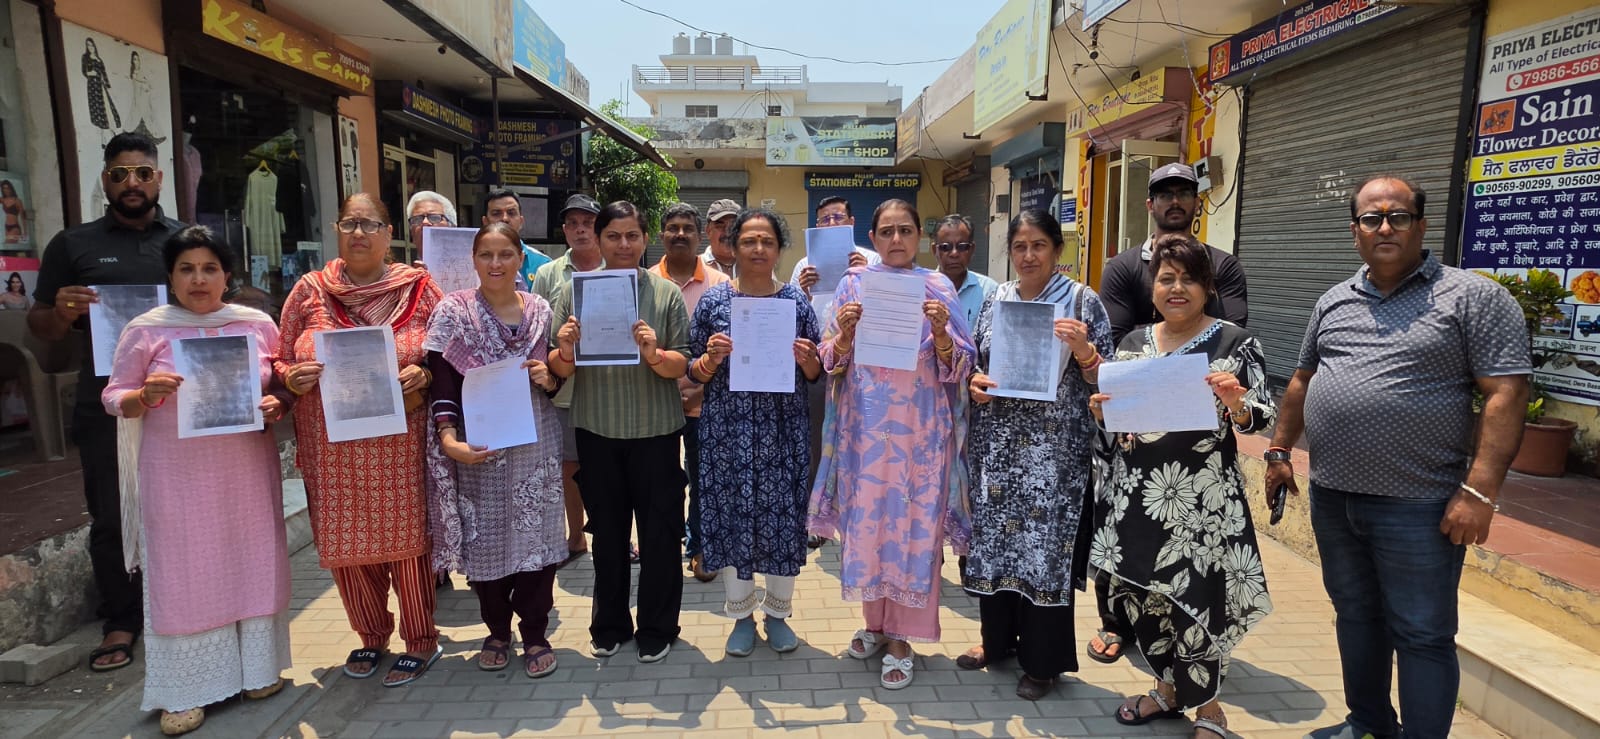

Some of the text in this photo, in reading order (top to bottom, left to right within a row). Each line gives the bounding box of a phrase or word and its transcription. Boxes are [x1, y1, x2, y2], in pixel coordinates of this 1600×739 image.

[1230, 61, 1240, 72] ALL
[1239, 56, 1256, 70] TYPES
[1264, 41, 1297, 61] ELECTRICAL
[1299, 32, 1318, 48] ITEMS
[1318, 17, 1354, 39] REPAIRING
[1241, 30, 1277, 59] PRIYA
[1492, 35, 1535, 60] PRIYA
[1489, 62, 1504, 75] All
[1507, 57, 1533, 71] Type
[1536, 50, 1549, 63] of
[312, 52, 371, 91] Camp
[412, 91, 473, 134] DASHMESH PHOTO FRAMING
[1520, 88, 1593, 127] Sain
[498, 121, 536, 132] DASHMESH
[817, 129, 896, 139] STATIONERY
[488, 132, 512, 143] POTO
[1477, 126, 1600, 154] Flower Decor
[823, 147, 889, 157] GIFT SHOP
[1482, 158, 1504, 176] ਸੈਨ
[809, 178, 864, 187] STATIONERY
[873, 179, 891, 187] GIFT
[894, 179, 918, 187] SHOP
[1485, 174, 1600, 194] 90569-90299, 905609
[1516, 196, 1527, 206] पर
[1530, 195, 1549, 206] कार,
[1554, 191, 1575, 203] प्रवेश
[1499, 211, 1533, 222] जयमाला,
[1562, 206, 1574, 218] की
[1558, 225, 1566, 234] व
[1570, 222, 1587, 234] फ्रेश
[1472, 240, 1486, 252] और
[1545, 238, 1565, 249] आदि
[1570, 237, 1579, 249] से
[1498, 257, 1509, 265] का
[1513, 254, 1534, 265] विशेष
[1566, 254, 1574, 265] है
[398, 659, 418, 668] LITE
